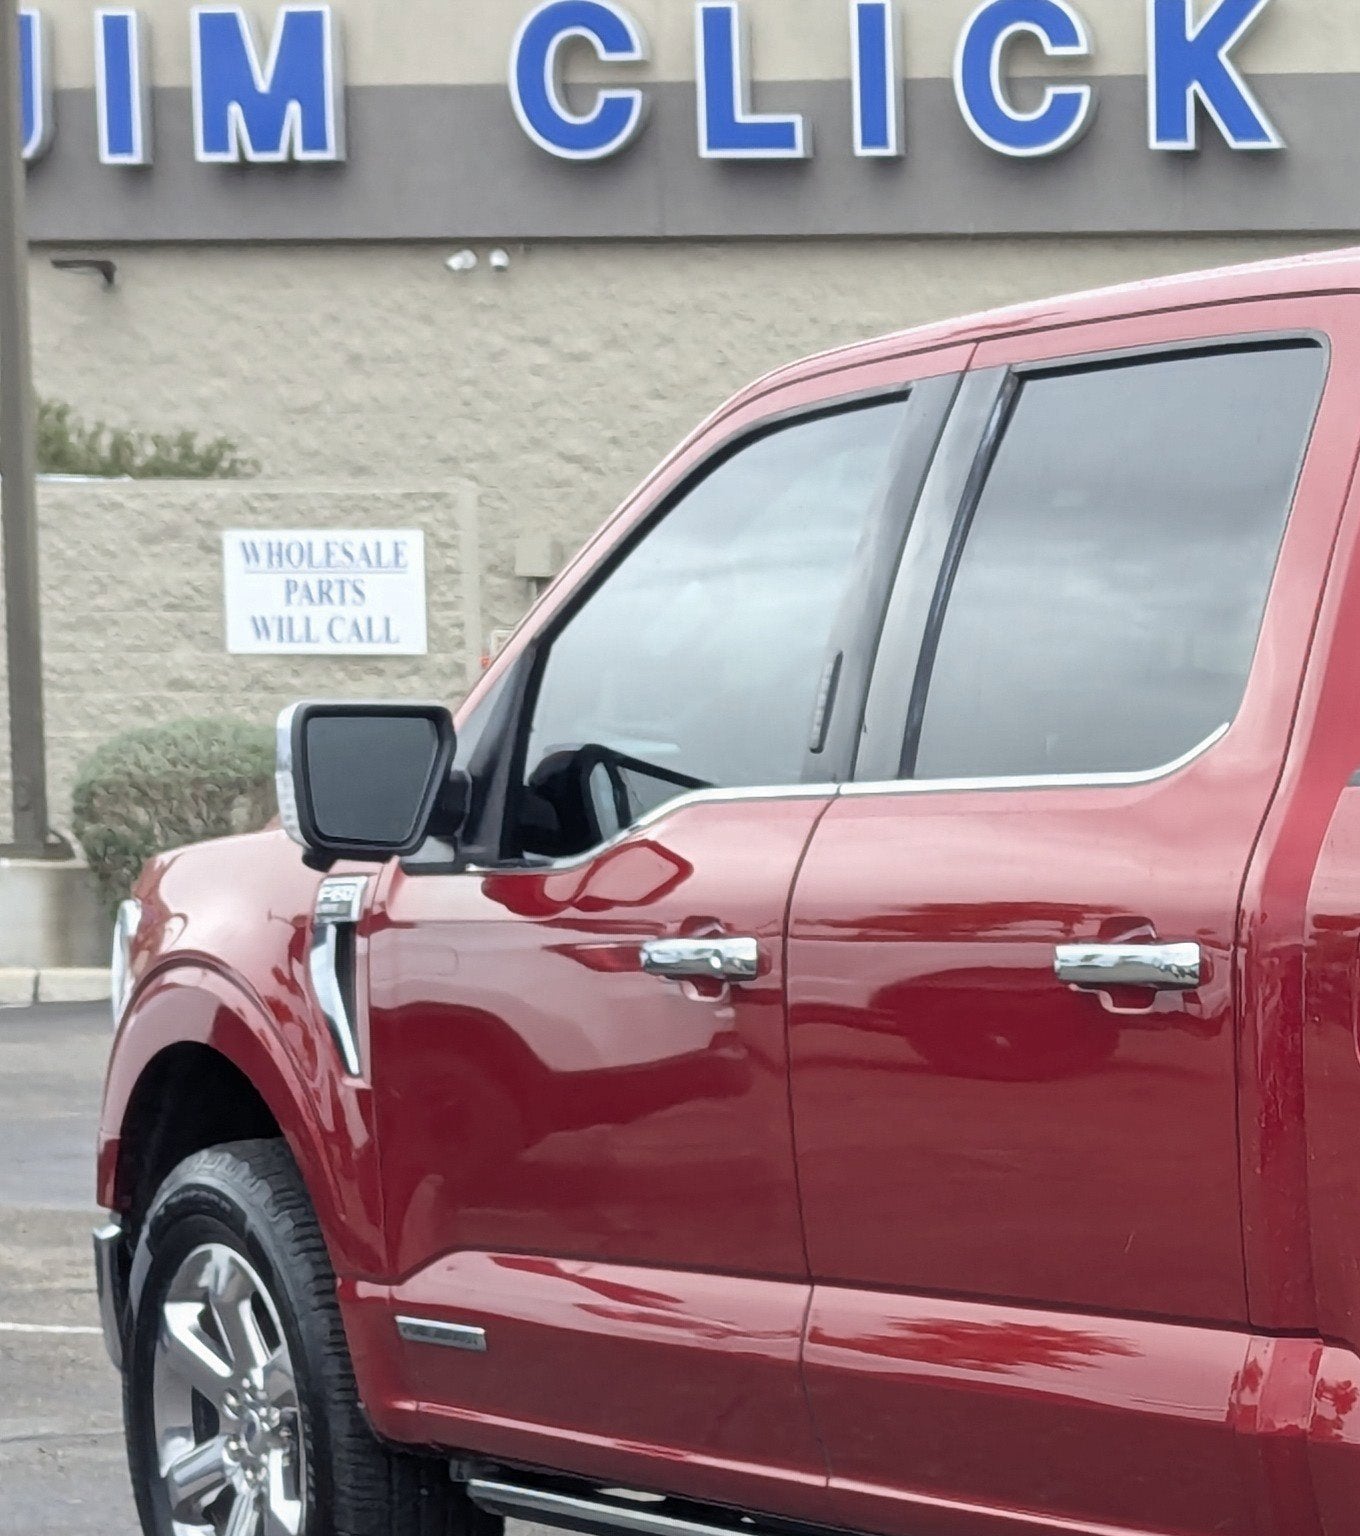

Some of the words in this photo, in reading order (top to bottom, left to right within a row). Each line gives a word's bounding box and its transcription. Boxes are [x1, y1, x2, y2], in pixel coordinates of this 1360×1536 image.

[508, 0, 1287, 160] CLICK
[240, 540, 409, 570] WHOLESALE
[283, 577, 366, 608] PARTS
[250, 614, 320, 644] WILL
[327, 616, 401, 644] CALL
